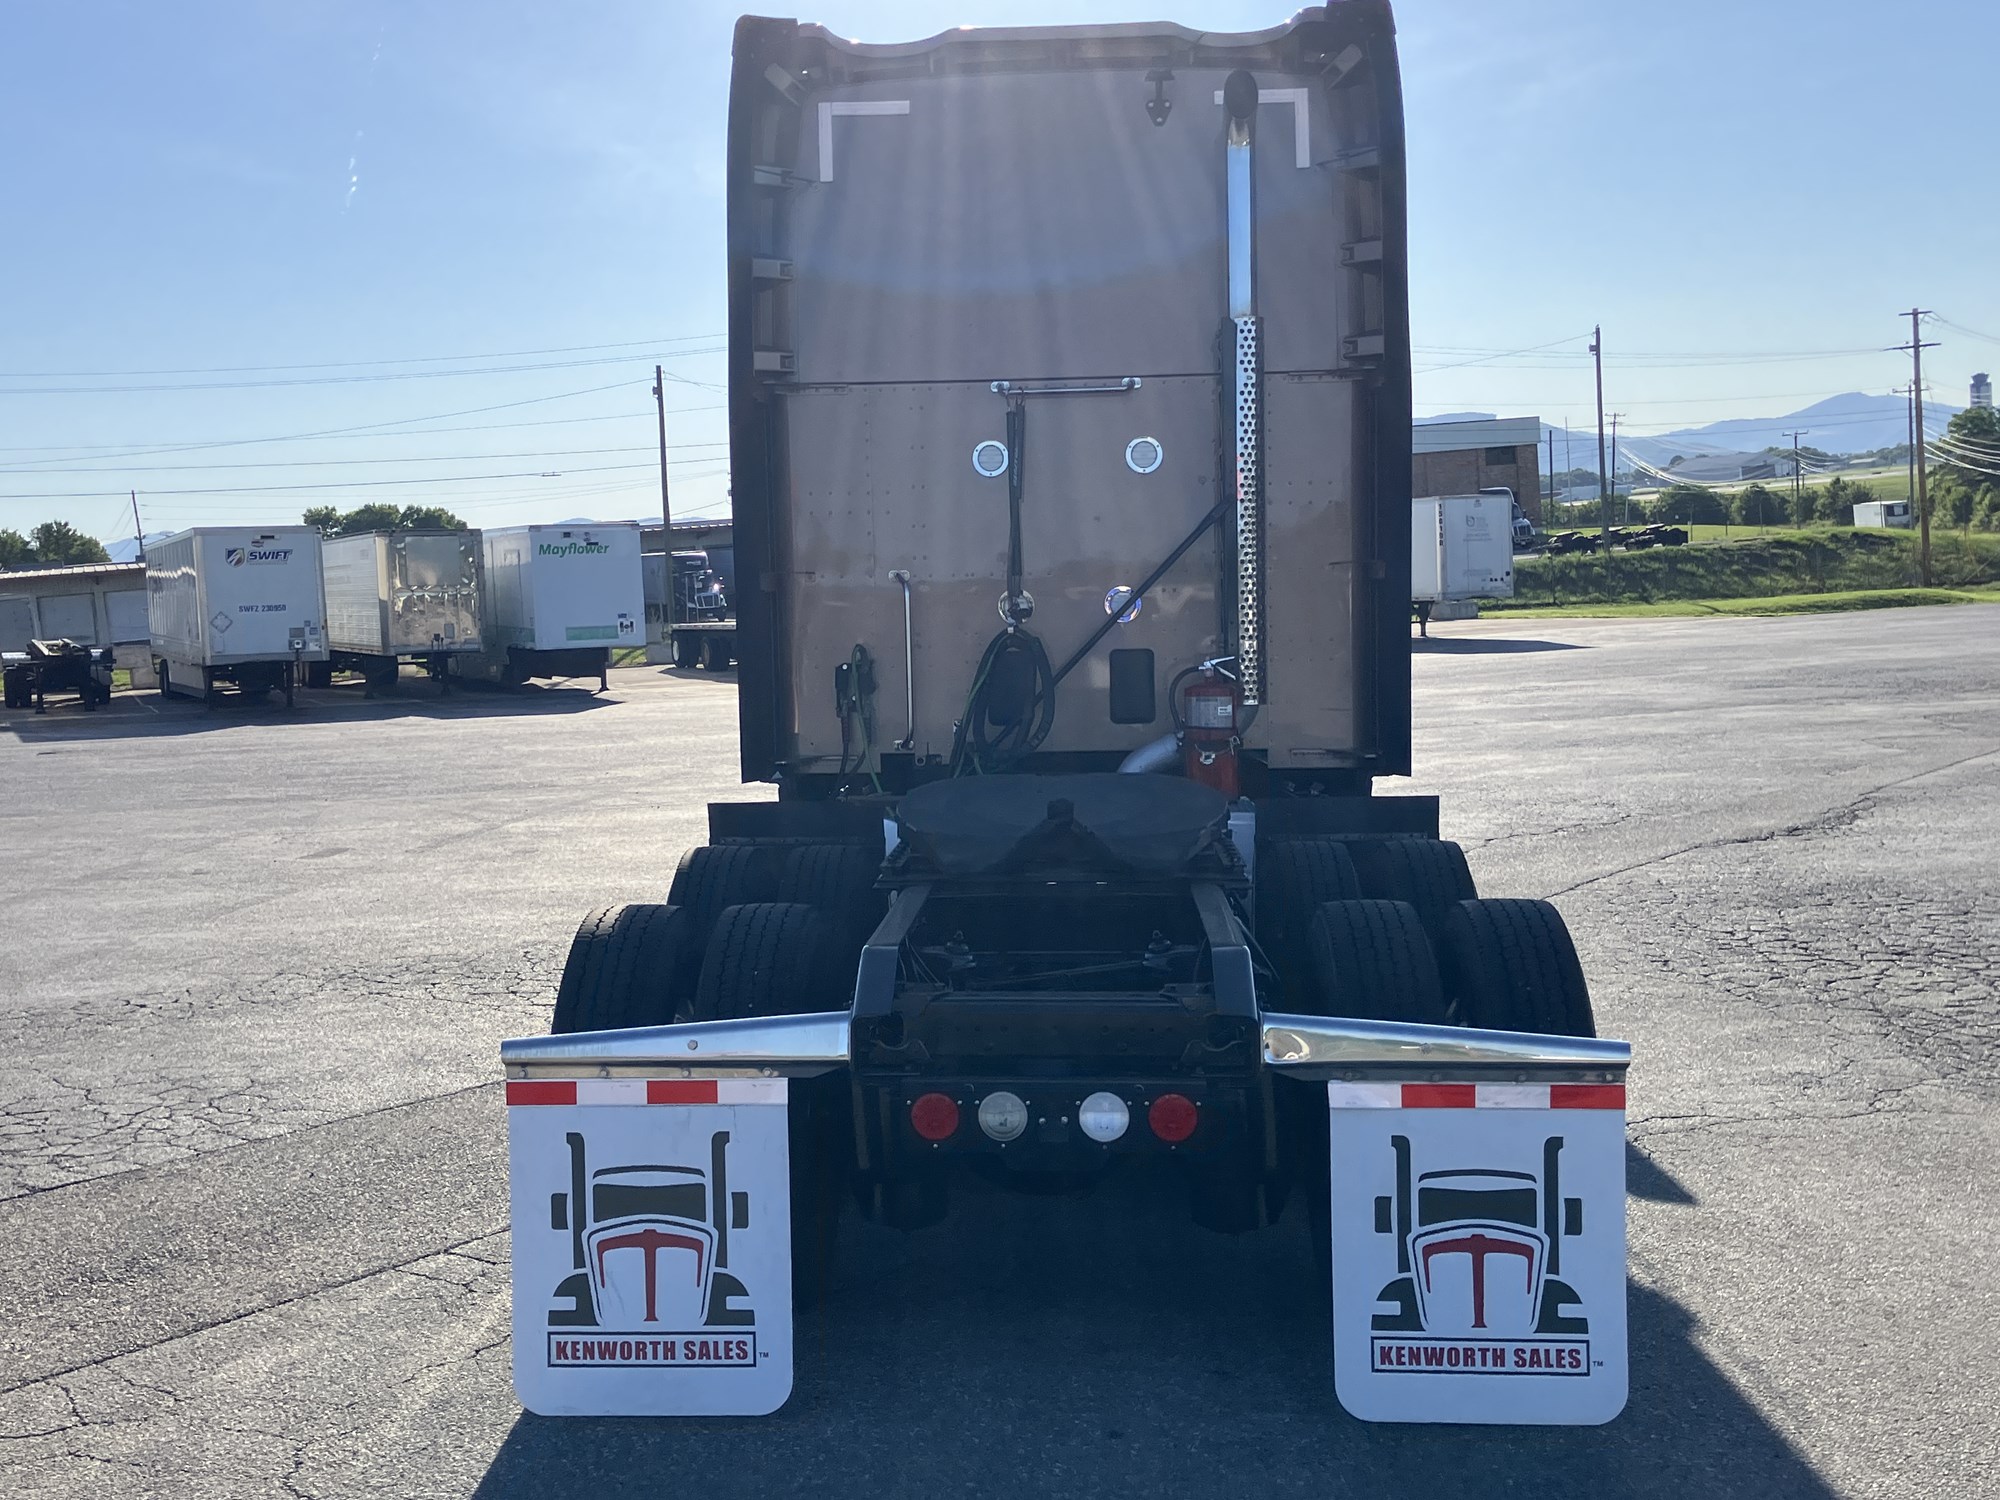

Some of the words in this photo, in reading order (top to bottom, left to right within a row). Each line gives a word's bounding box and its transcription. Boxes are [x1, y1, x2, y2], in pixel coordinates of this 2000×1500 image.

[249, 551, 291, 560] SWIFT
[539, 542, 609, 558] Mayflower
[555, 1340, 676, 1361] KENWORTH
[683, 1340, 749, 1361] SALES
[1380, 1345, 1506, 1367] KENWORTH
[1513, 1348, 1582, 1369] SALES
